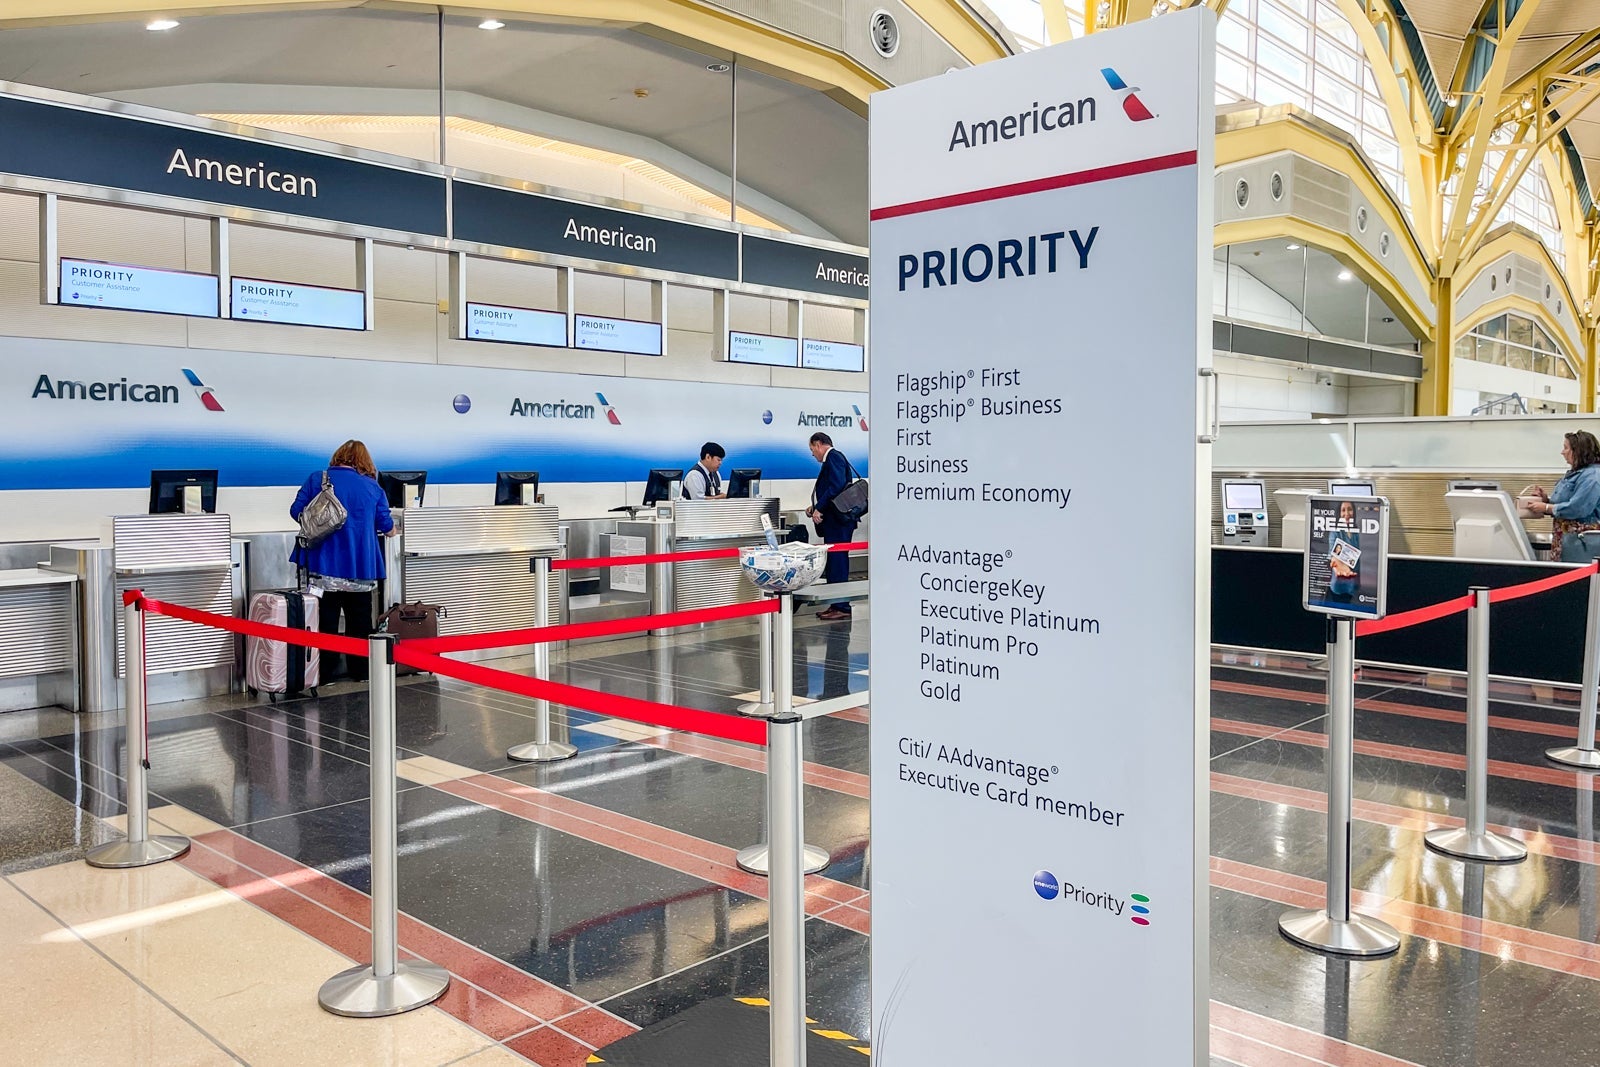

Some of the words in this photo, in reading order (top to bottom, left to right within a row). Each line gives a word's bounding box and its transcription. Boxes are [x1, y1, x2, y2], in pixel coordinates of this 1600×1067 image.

[948, 96, 1096, 152] American
[166, 148, 318, 198] American
[562, 217, 657, 253] American
[898, 226, 1100, 292] PRIORITY
[71, 267, 134, 282] PRIORITY
[71, 279, 105, 288] Customer
[815, 262, 870, 287] America
[240, 285, 293, 298] PRIORITY
[473, 309, 513, 320] PRIORITY
[581, 320, 615, 331] PRIORITY
[734, 336, 762, 346] PRIORITY
[806, 343, 831, 352] PRIORITY
[31, 374, 179, 403] American
[897, 369, 975, 396] Flagship®
[981, 368, 1021, 388] First
[509, 397, 595, 419] American
[797, 410, 853, 427] American
[897, 398, 975, 424] Flagship®
[981, 395, 1062, 416] Business
[897, 428, 932, 446] First
[896, 455, 969, 473] Business
[896, 482, 975, 501] Premium
[982, 483, 1072, 509] Economy
[1361, 518, 1380, 534] ID
[897, 544, 1013, 573] AAdvantage®
[920, 572, 1045, 605] ConciergeKey
[920, 599, 1004, 624] Executive
[1010, 607, 1100, 634] Platinum
[920, 626, 999, 652] Platinum
[1006, 635, 1039, 657] Pro
[920, 653, 999, 680] Platinum
[920, 680, 961, 702] Gold
[898, 737, 932, 759] Citi/
[899, 763, 980, 797] Executive
[986, 781, 1028, 808] Card
[1035, 794, 1125, 827] member
[1064, 882, 1125, 916] Priority
